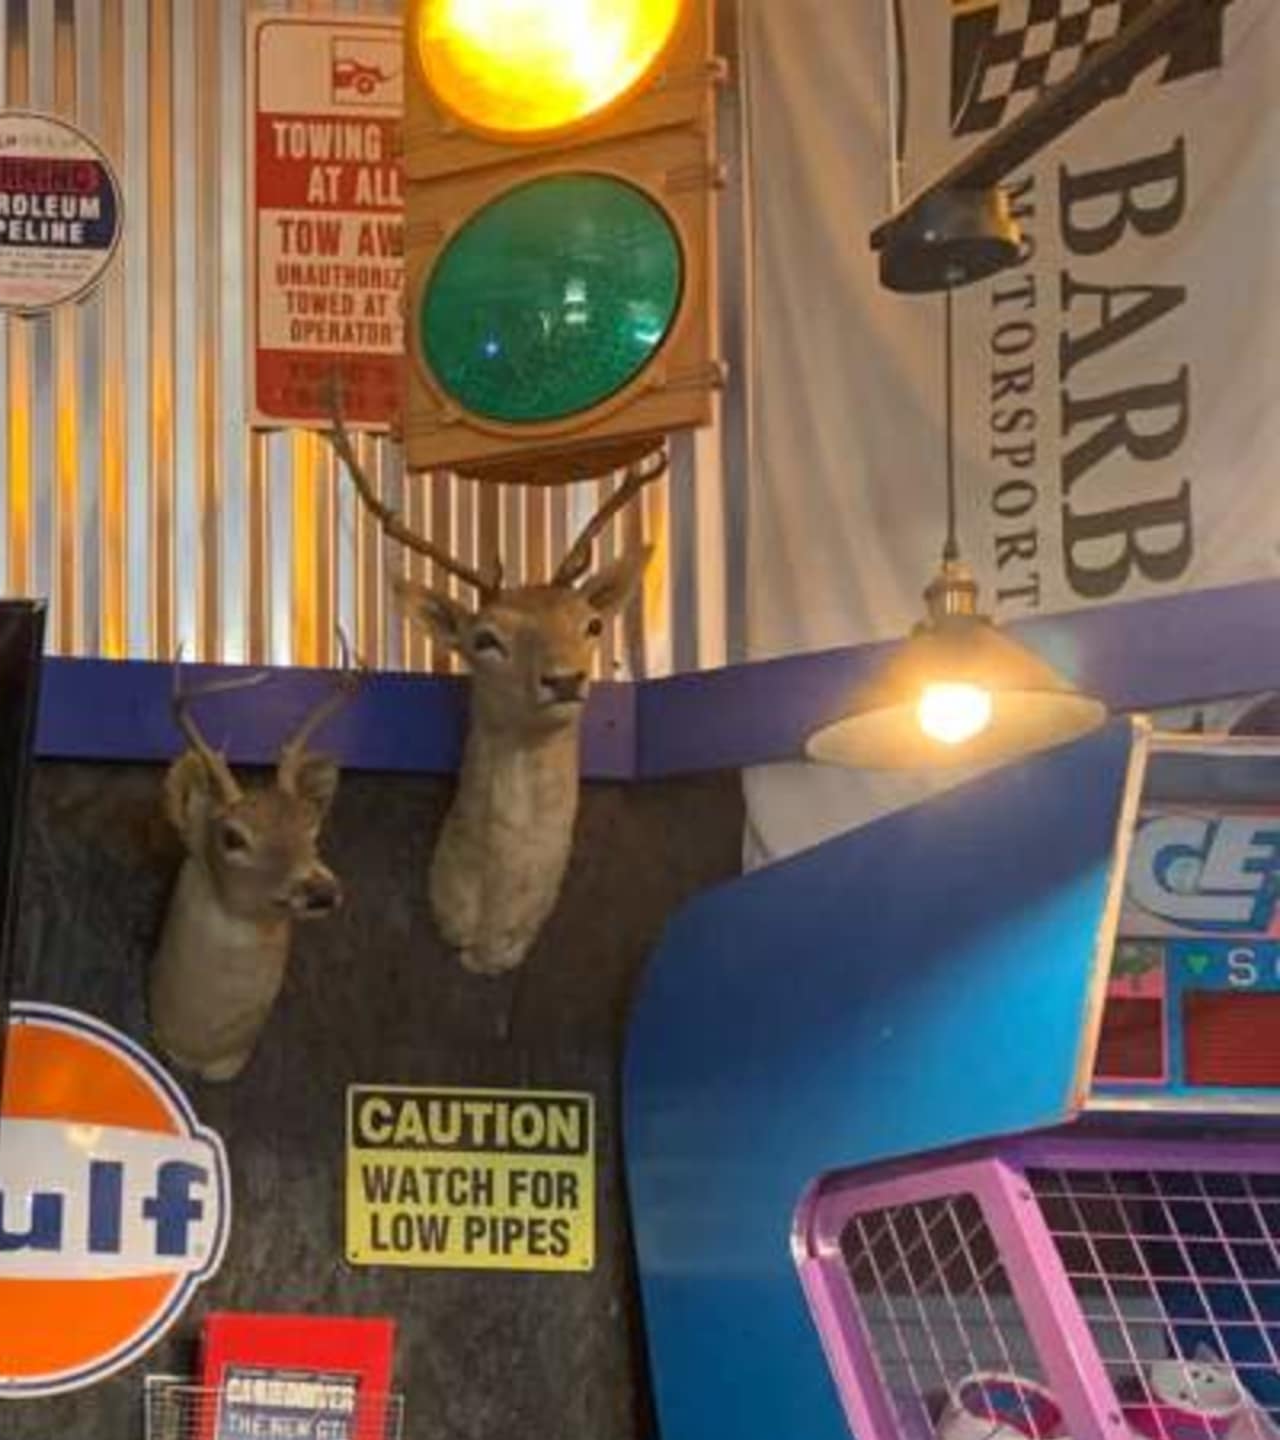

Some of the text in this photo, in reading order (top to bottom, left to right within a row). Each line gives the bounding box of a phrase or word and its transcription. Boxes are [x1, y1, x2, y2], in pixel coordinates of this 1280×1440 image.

[272, 121, 382, 160] TOWING
[308, 165, 403, 206] AT ALL
[278, 219, 341, 256] TOW
[286, 291, 387, 317] TOWED AT
[989, 174, 1042, 608] MTORSPORT
[358, 1096, 582, 1149] CAUTION
[361, 1164, 579, 1211] WATCH FOR
[370, 1212, 571, 1257] LOW PIPES
